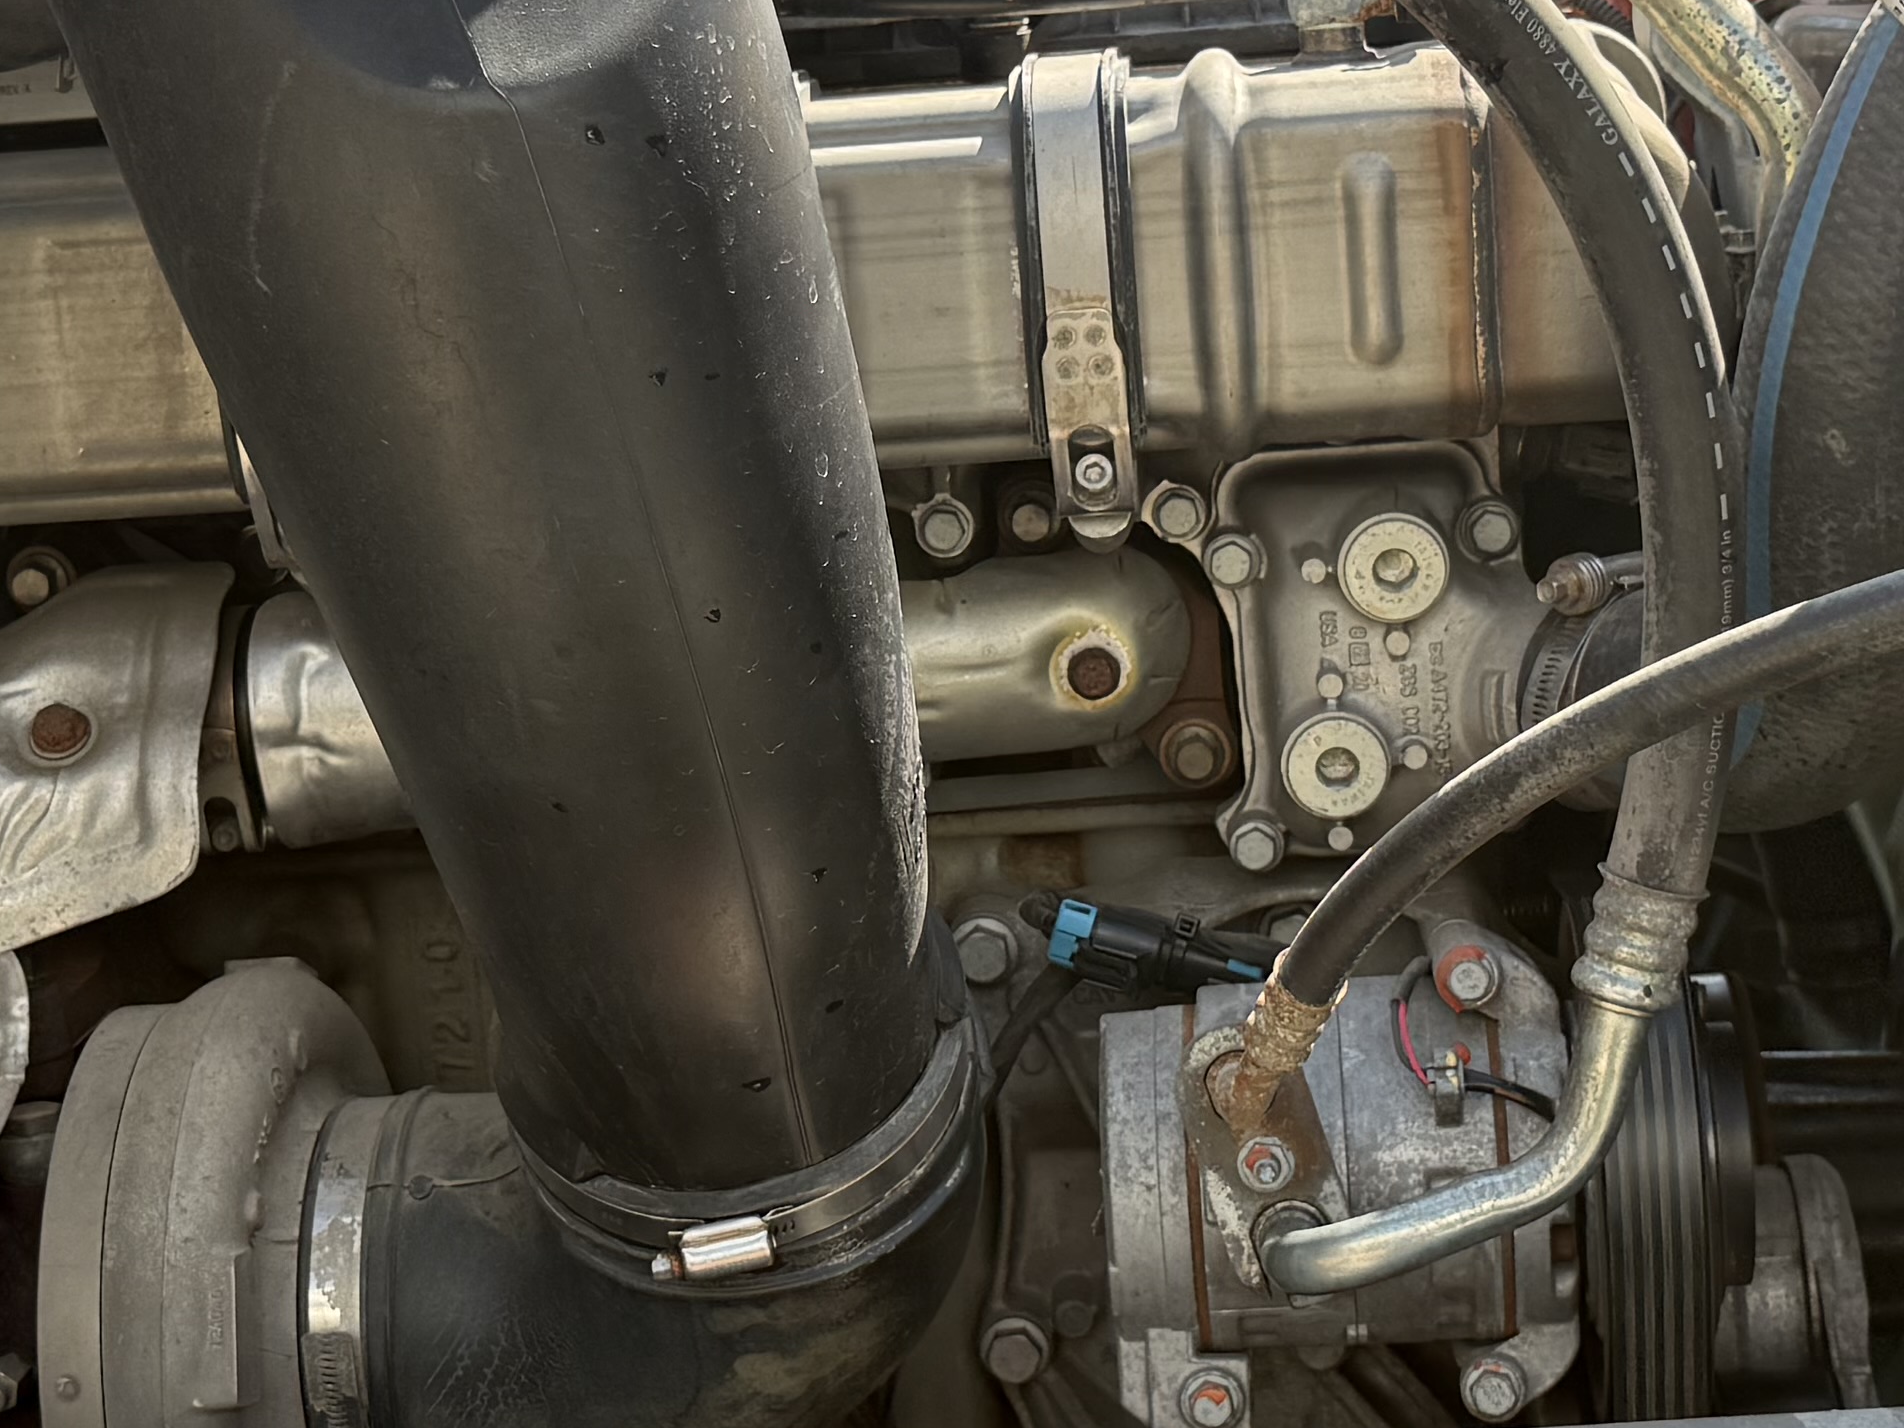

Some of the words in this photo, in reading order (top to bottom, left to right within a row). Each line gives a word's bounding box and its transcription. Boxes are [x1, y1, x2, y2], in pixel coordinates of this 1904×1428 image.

[1523, 16, 1560, 57] 4880
[1552, 56, 1622, 147] GALAXY
[1318, 609, 1338, 649] USA
